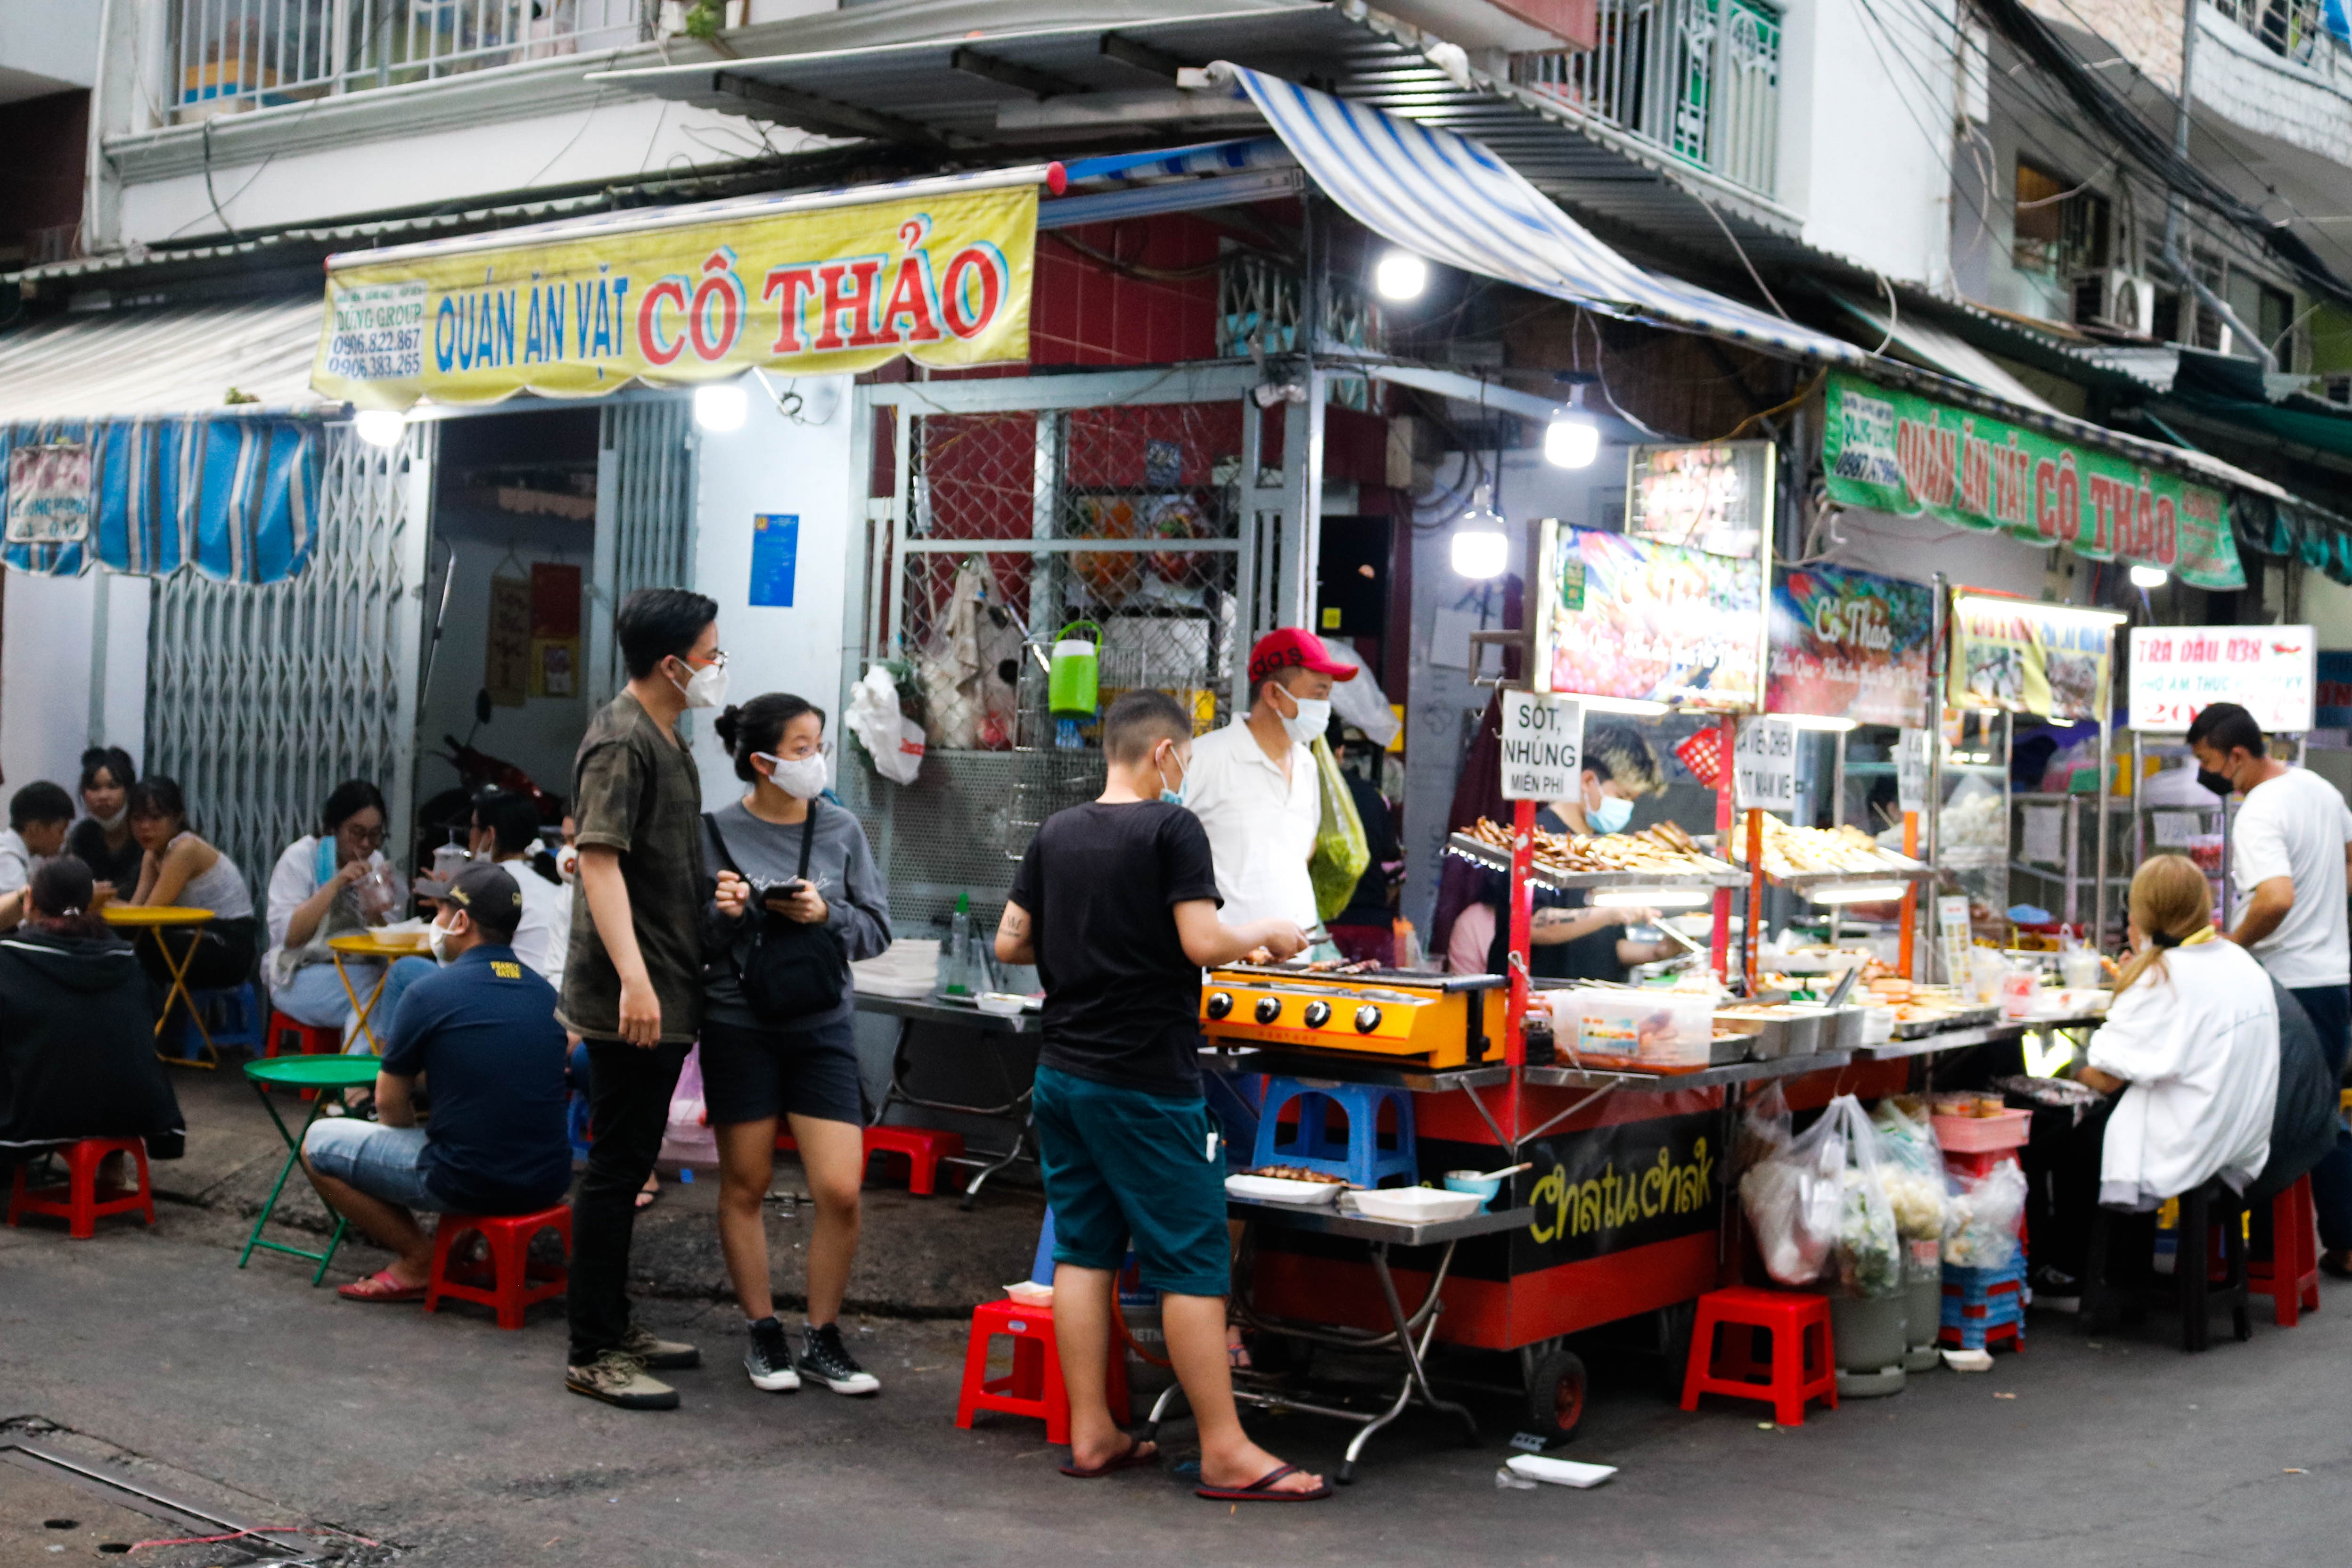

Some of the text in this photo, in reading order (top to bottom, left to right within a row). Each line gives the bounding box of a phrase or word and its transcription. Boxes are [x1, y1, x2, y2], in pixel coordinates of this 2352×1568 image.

[377, 303, 422, 328] GROUP
[435, 213, 1008, 379] QUÁN ĂN VẶT CÔ THẢO
[1896, 409, 1956, 507] QUÁN
[1959, 418, 1990, 516] ĂN
[2035, 449, 2080, 542] CÔ
[2089, 468, 2177, 565] THẢO
[1816, 596, 1846, 643] Cô
[1504, 735, 1576, 767] NHÚNG
